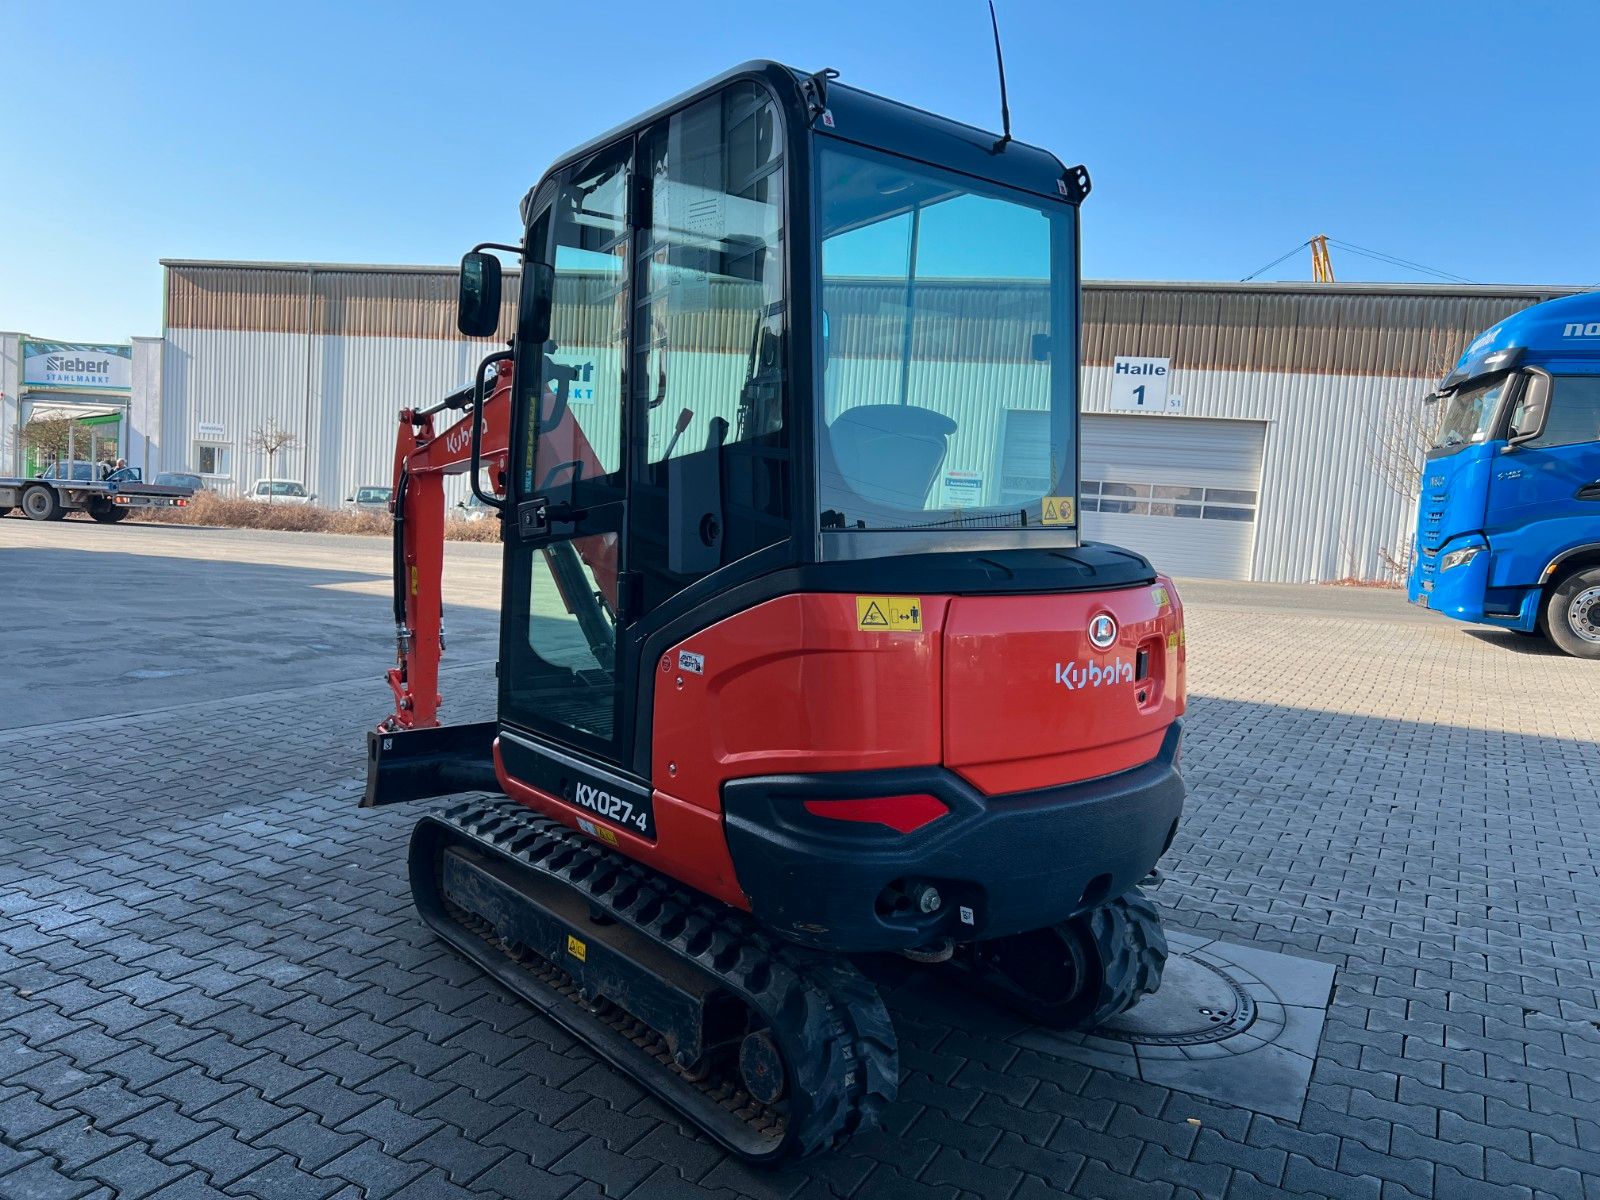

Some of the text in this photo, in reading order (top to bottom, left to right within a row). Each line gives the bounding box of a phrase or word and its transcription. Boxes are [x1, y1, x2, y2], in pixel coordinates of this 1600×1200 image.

[46, 356, 110, 373] Siebert
[1115, 362, 1167, 376] Halle
[46, 373, 109, 384] STAHLMARKT
[1132, 384, 1146, 406] 1
[1055, 656, 1134, 691] Kubota
[575, 781, 647, 832] KX027-4
